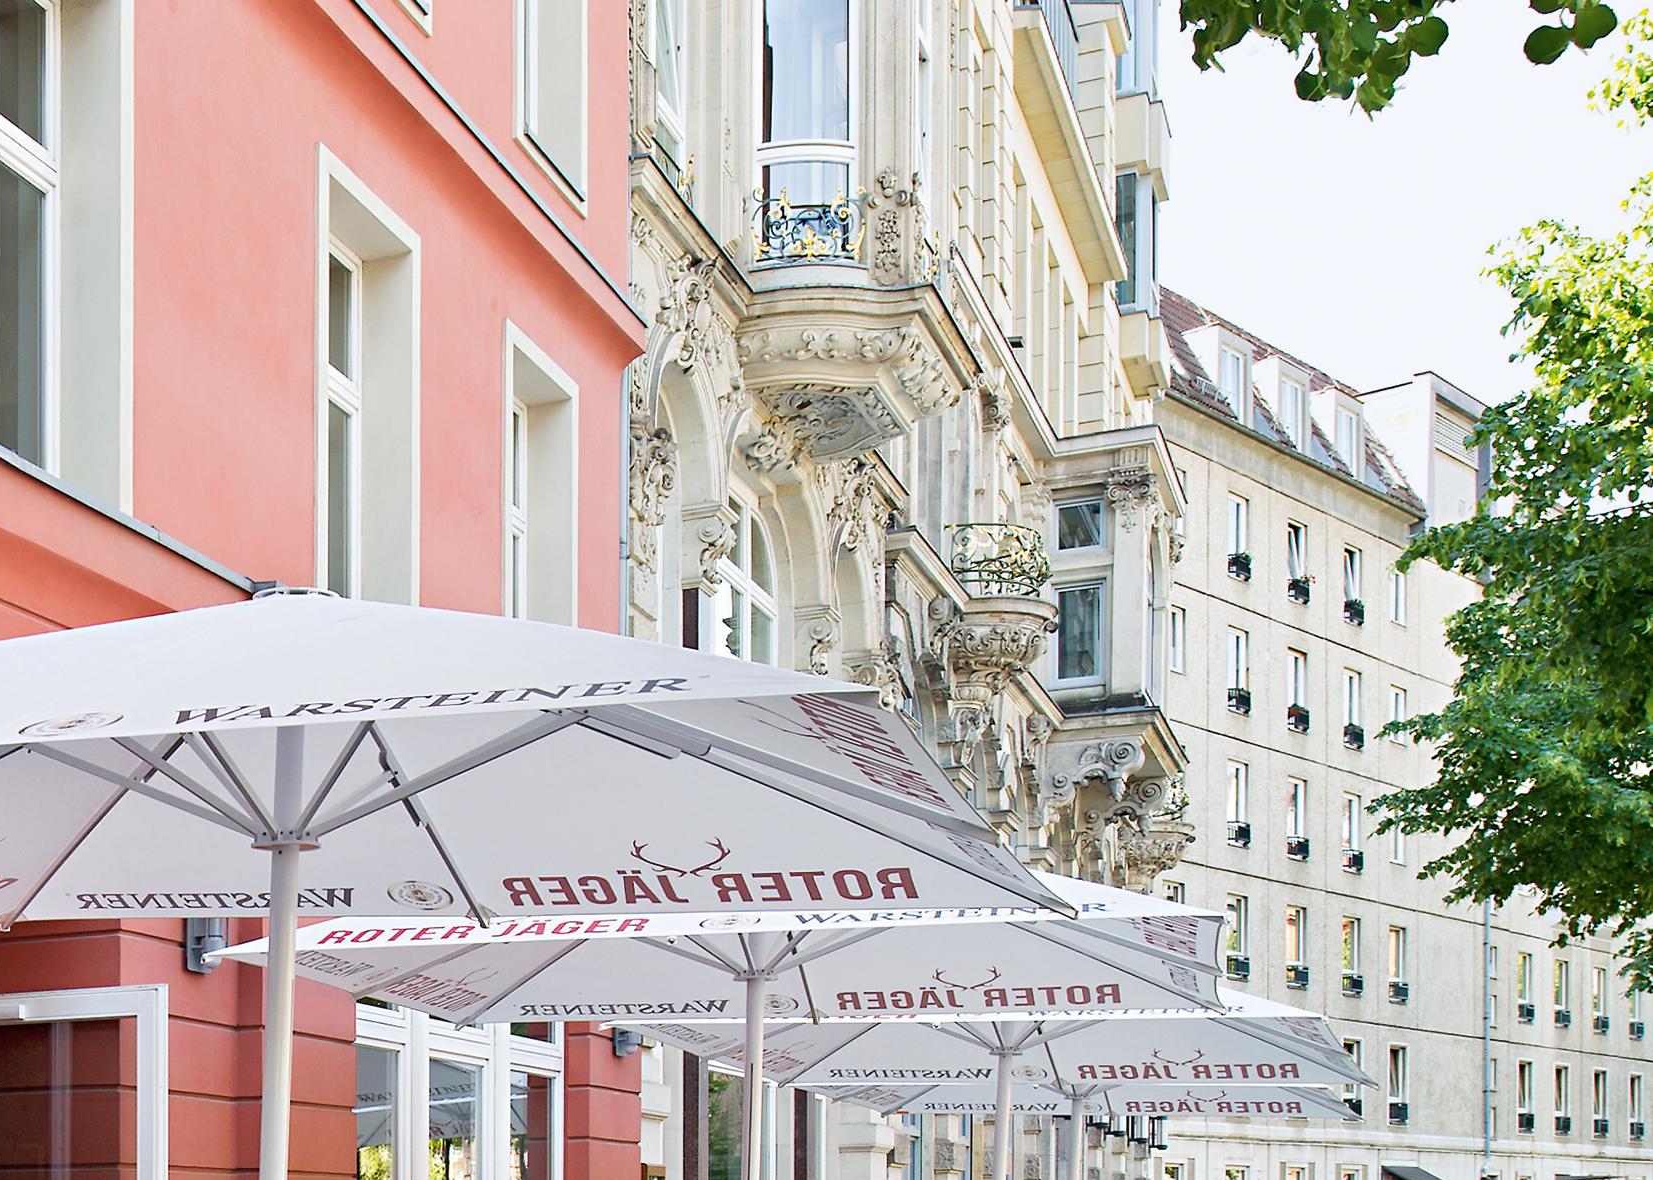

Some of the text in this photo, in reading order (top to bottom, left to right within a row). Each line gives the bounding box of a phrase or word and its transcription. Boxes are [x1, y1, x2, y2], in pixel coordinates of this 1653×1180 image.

[175, 678, 692, 725] WARSTEINER
[795, 902, 1109, 924] WARSTEINR
[317, 918, 650, 945] ROTER JÄGER
